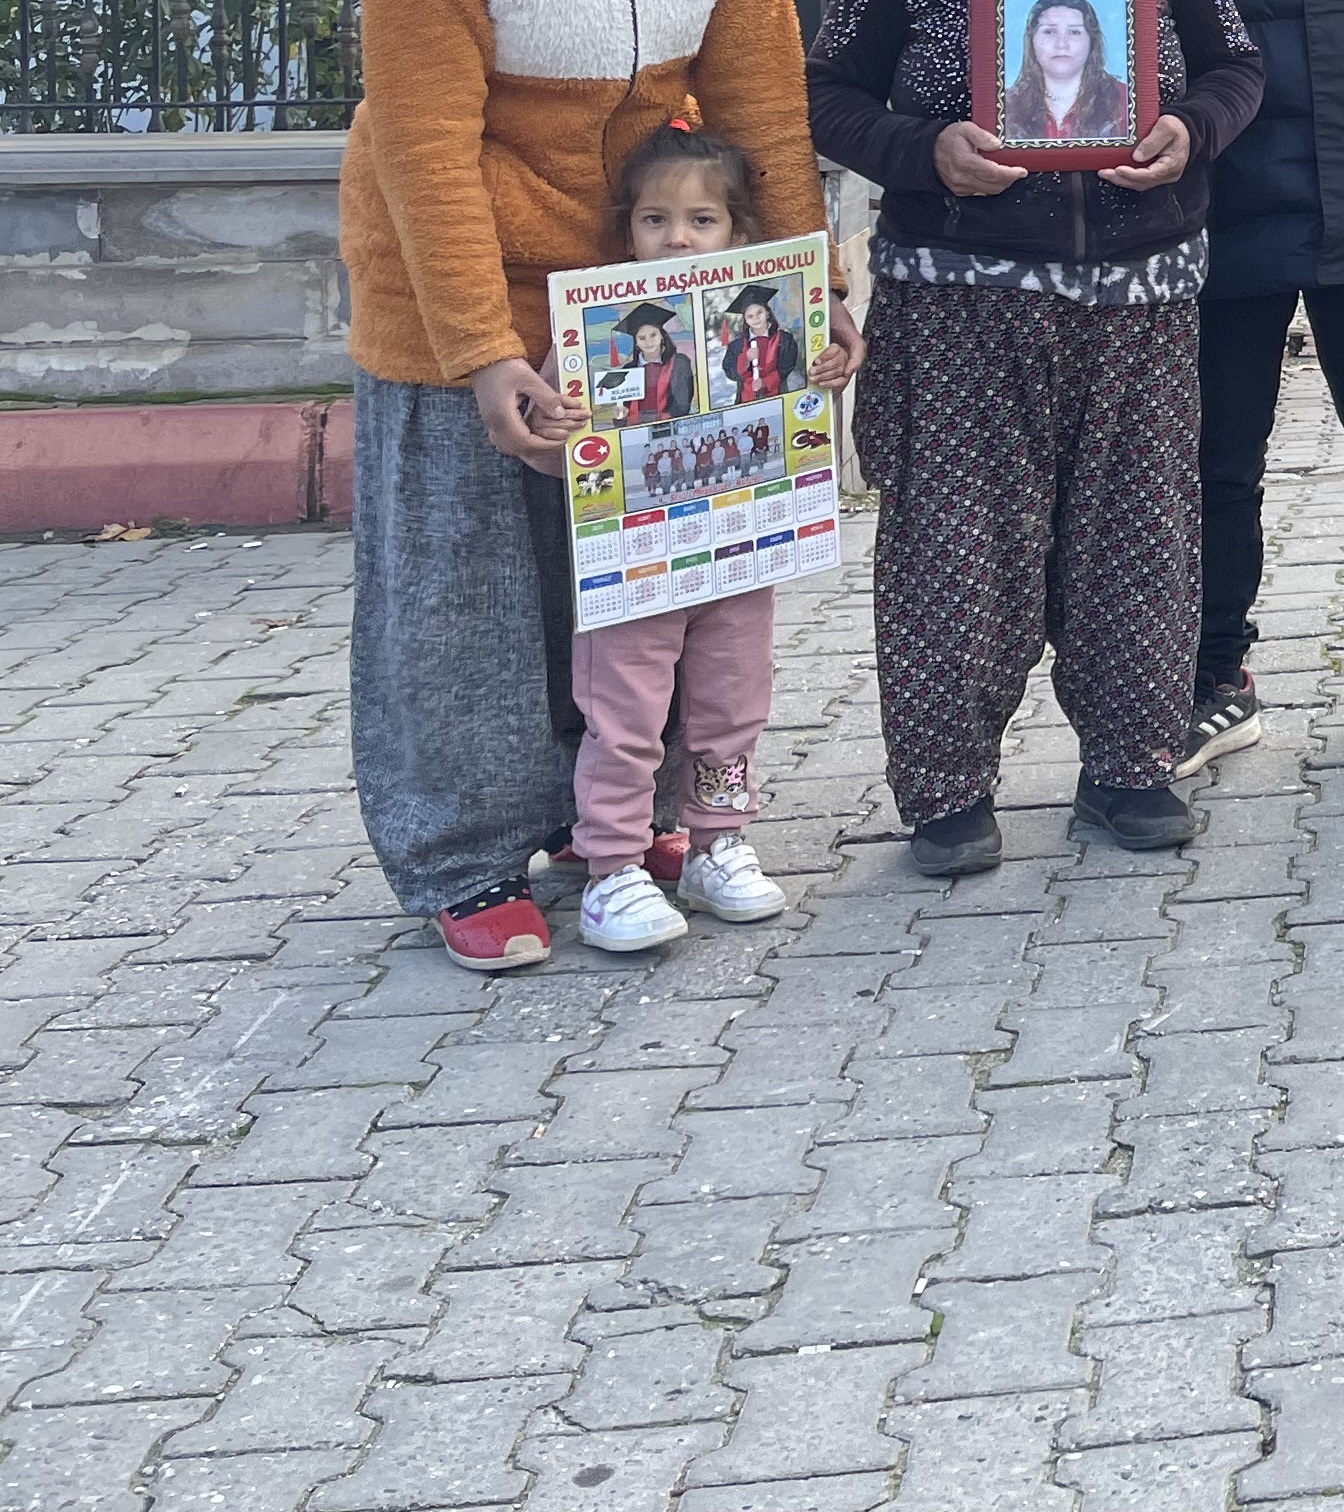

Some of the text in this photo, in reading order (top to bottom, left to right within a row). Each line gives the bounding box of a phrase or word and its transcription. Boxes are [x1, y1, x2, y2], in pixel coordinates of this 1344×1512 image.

[565, 250, 815, 306] KUYUCAK BAŞARAN İLKOKULU
